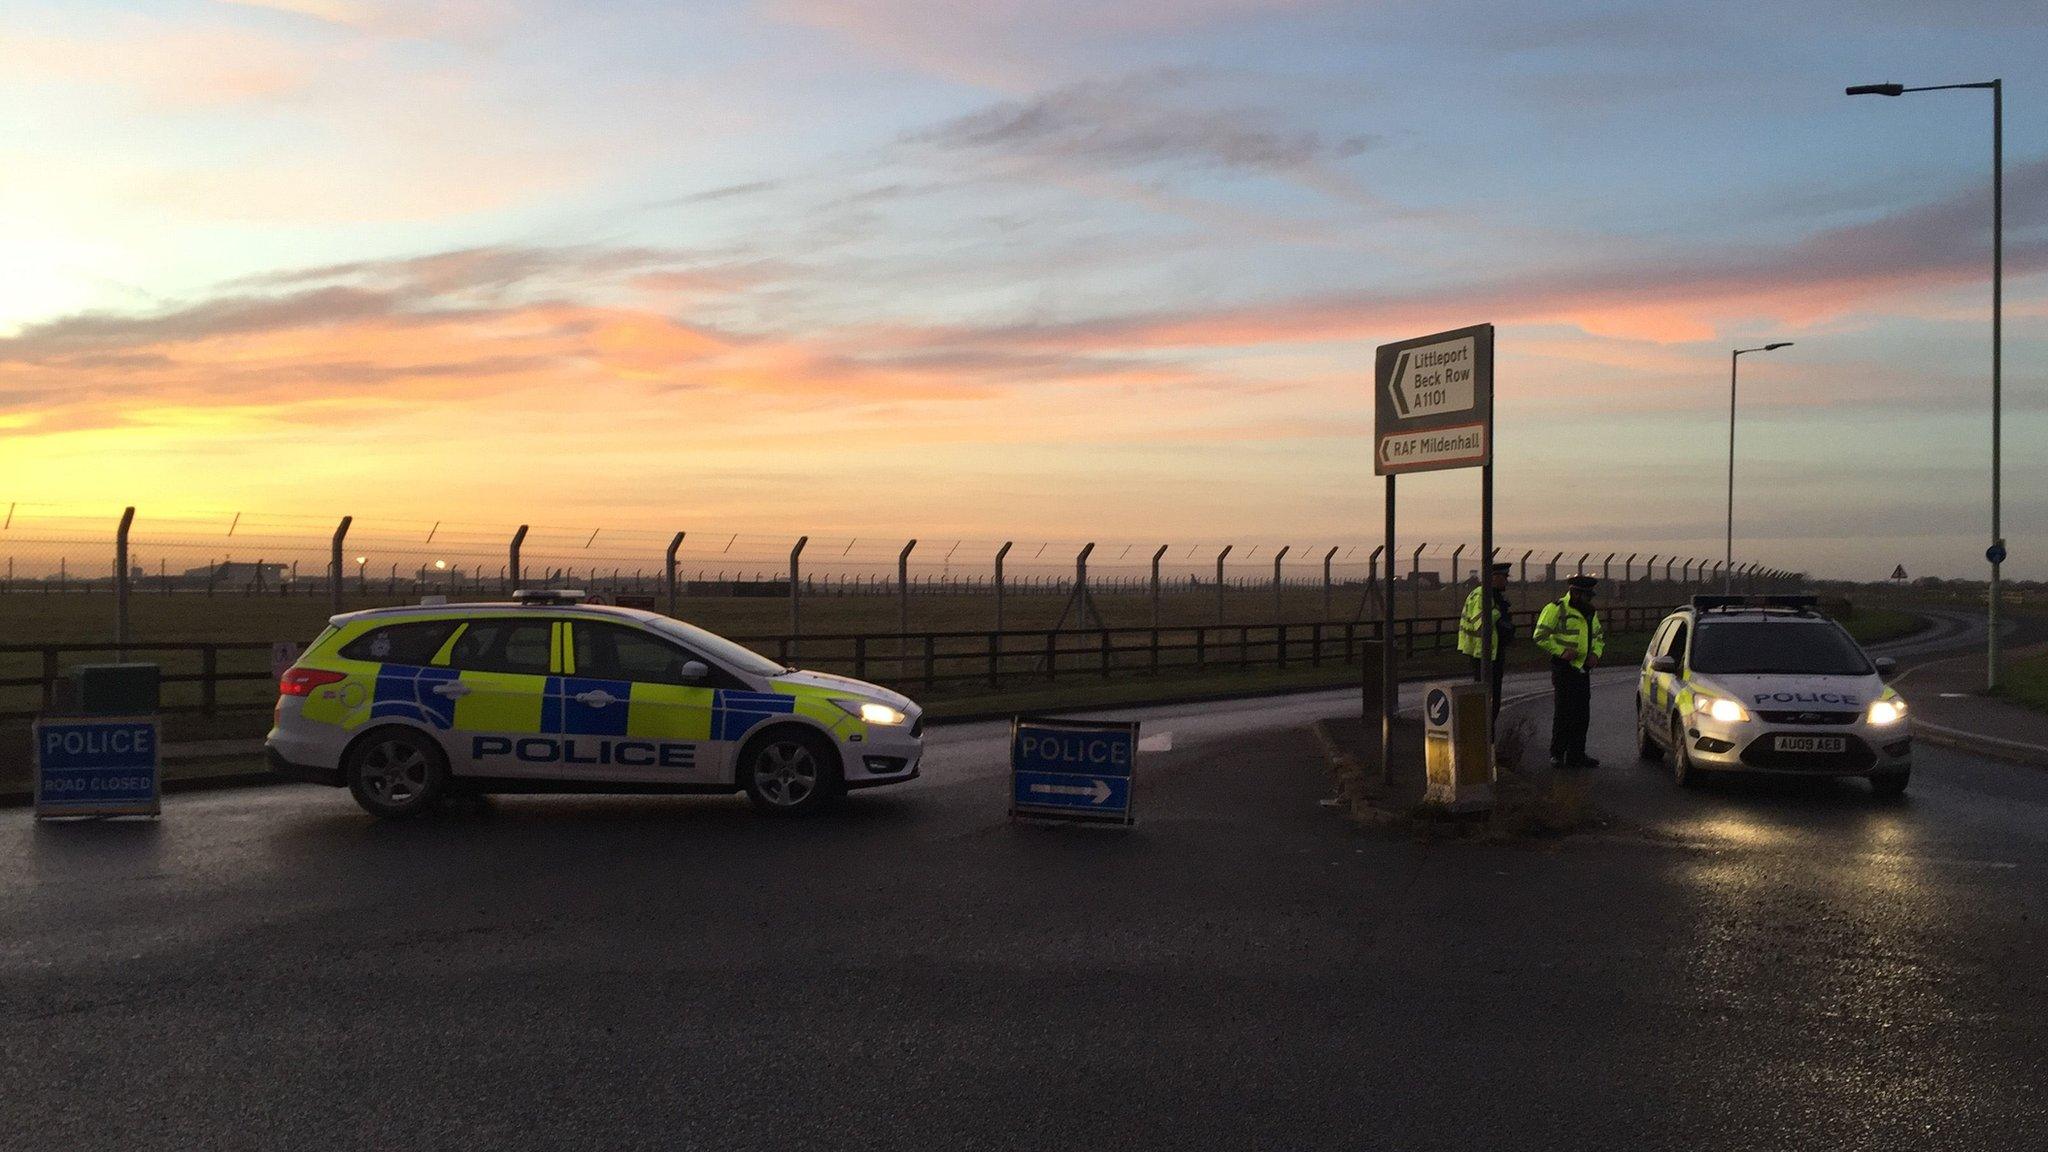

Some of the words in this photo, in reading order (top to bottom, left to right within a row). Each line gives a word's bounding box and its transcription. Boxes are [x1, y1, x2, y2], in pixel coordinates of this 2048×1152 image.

[1414, 345, 1468, 369] Littleport
[1414, 371, 1441, 389] Beck
[1445, 368, 1470, 384] Row
[1413, 389, 1446, 409] A1101
[1394, 440, 1417, 456] RAF
[1420, 432, 1480, 455] Mildenhall
[1753, 692, 1860, 706] POLICE
[46, 729, 149, 755] POLICE
[472, 736, 697, 768] POLICE
[1022, 737, 1127, 764] POLICE
[1779, 740, 1814, 751] AU09
[44, 778, 87, 791] ROAD
[90, 776, 151, 791] CLOSED
